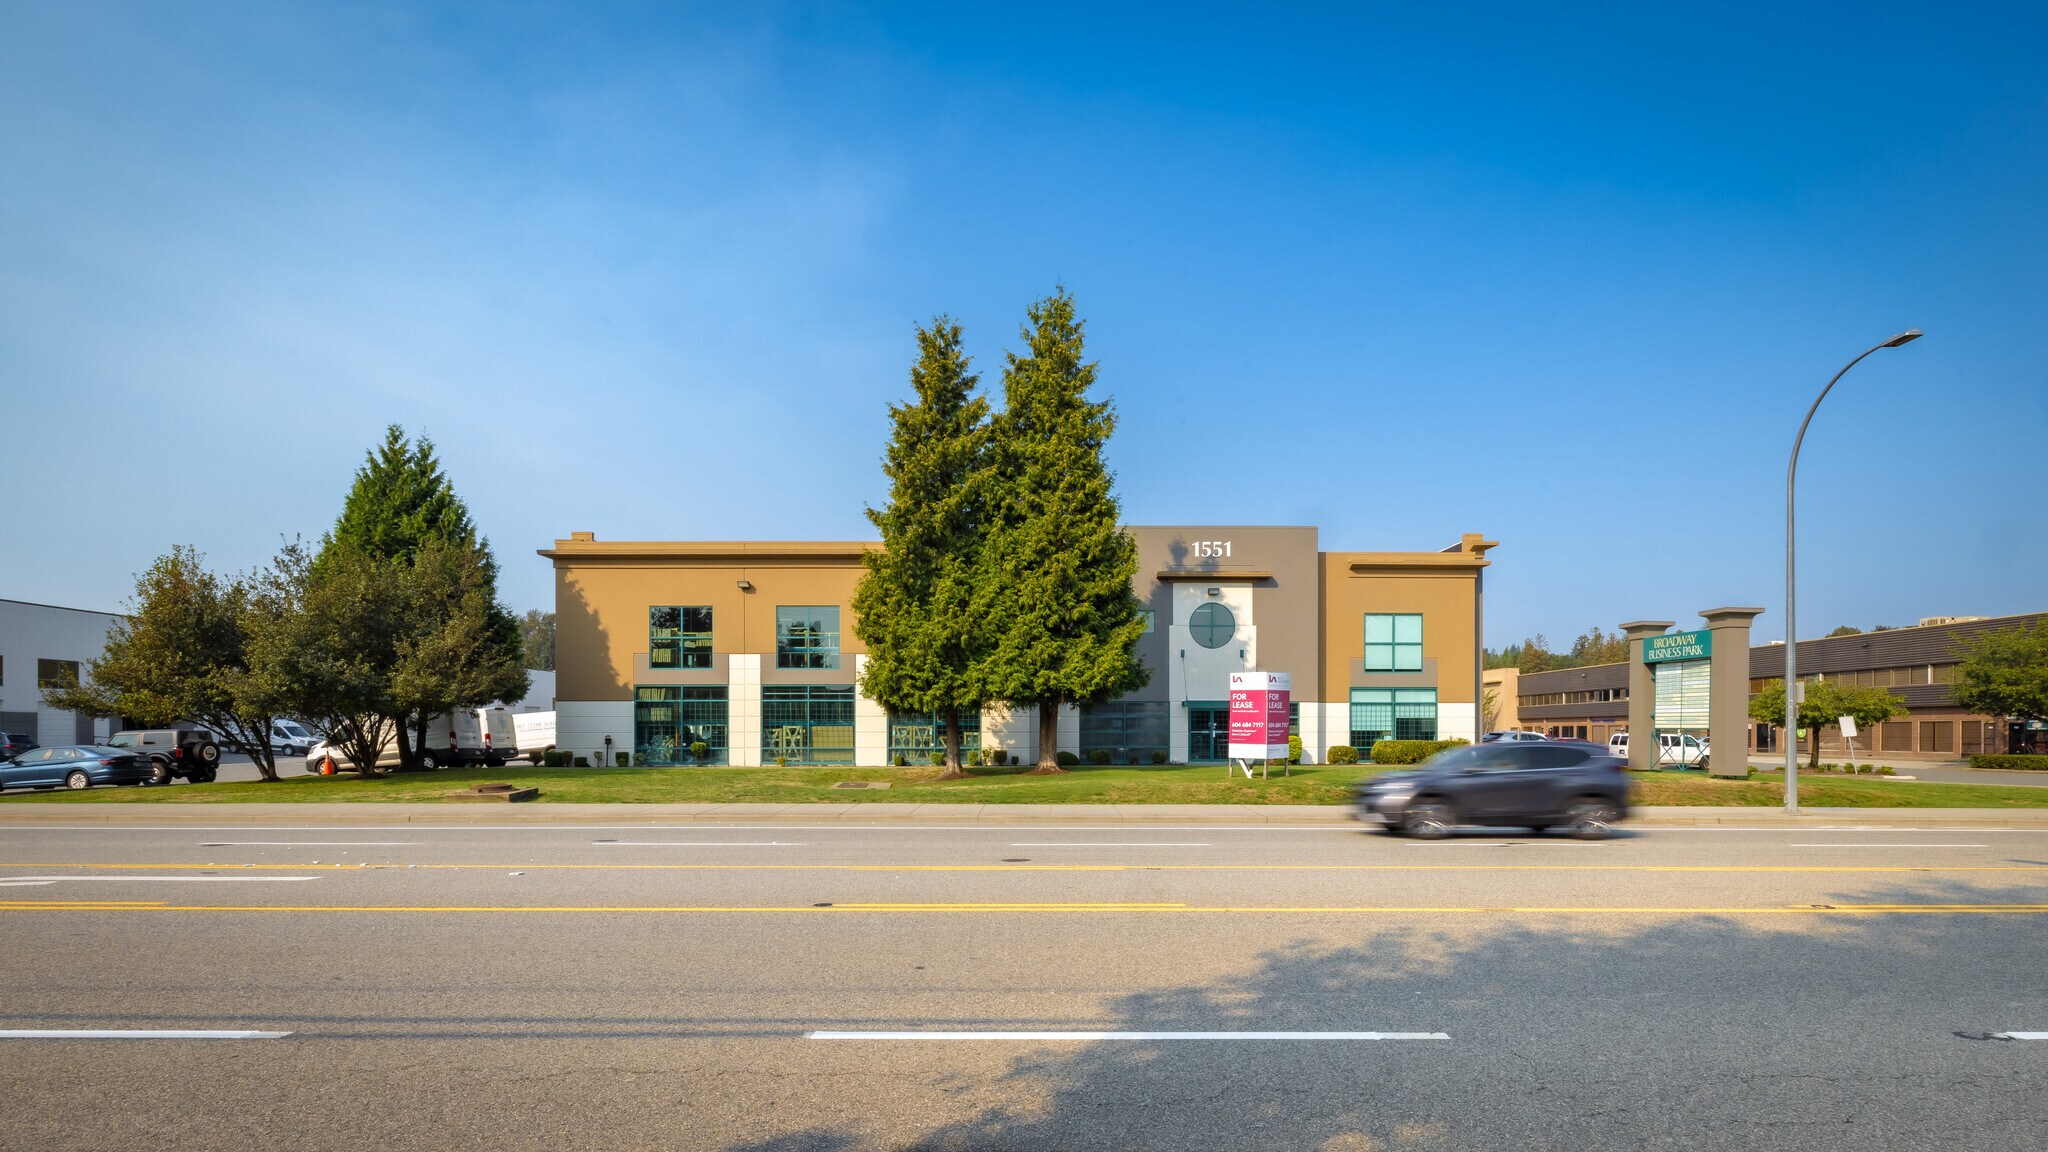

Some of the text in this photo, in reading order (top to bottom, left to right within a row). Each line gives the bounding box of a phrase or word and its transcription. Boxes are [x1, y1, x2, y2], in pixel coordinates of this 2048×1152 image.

[1192, 541, 1232, 558] 1551
[1654, 634, 1696, 648] BROADWAY
[1648, 645, 1703, 660] BUSINESS PARK
